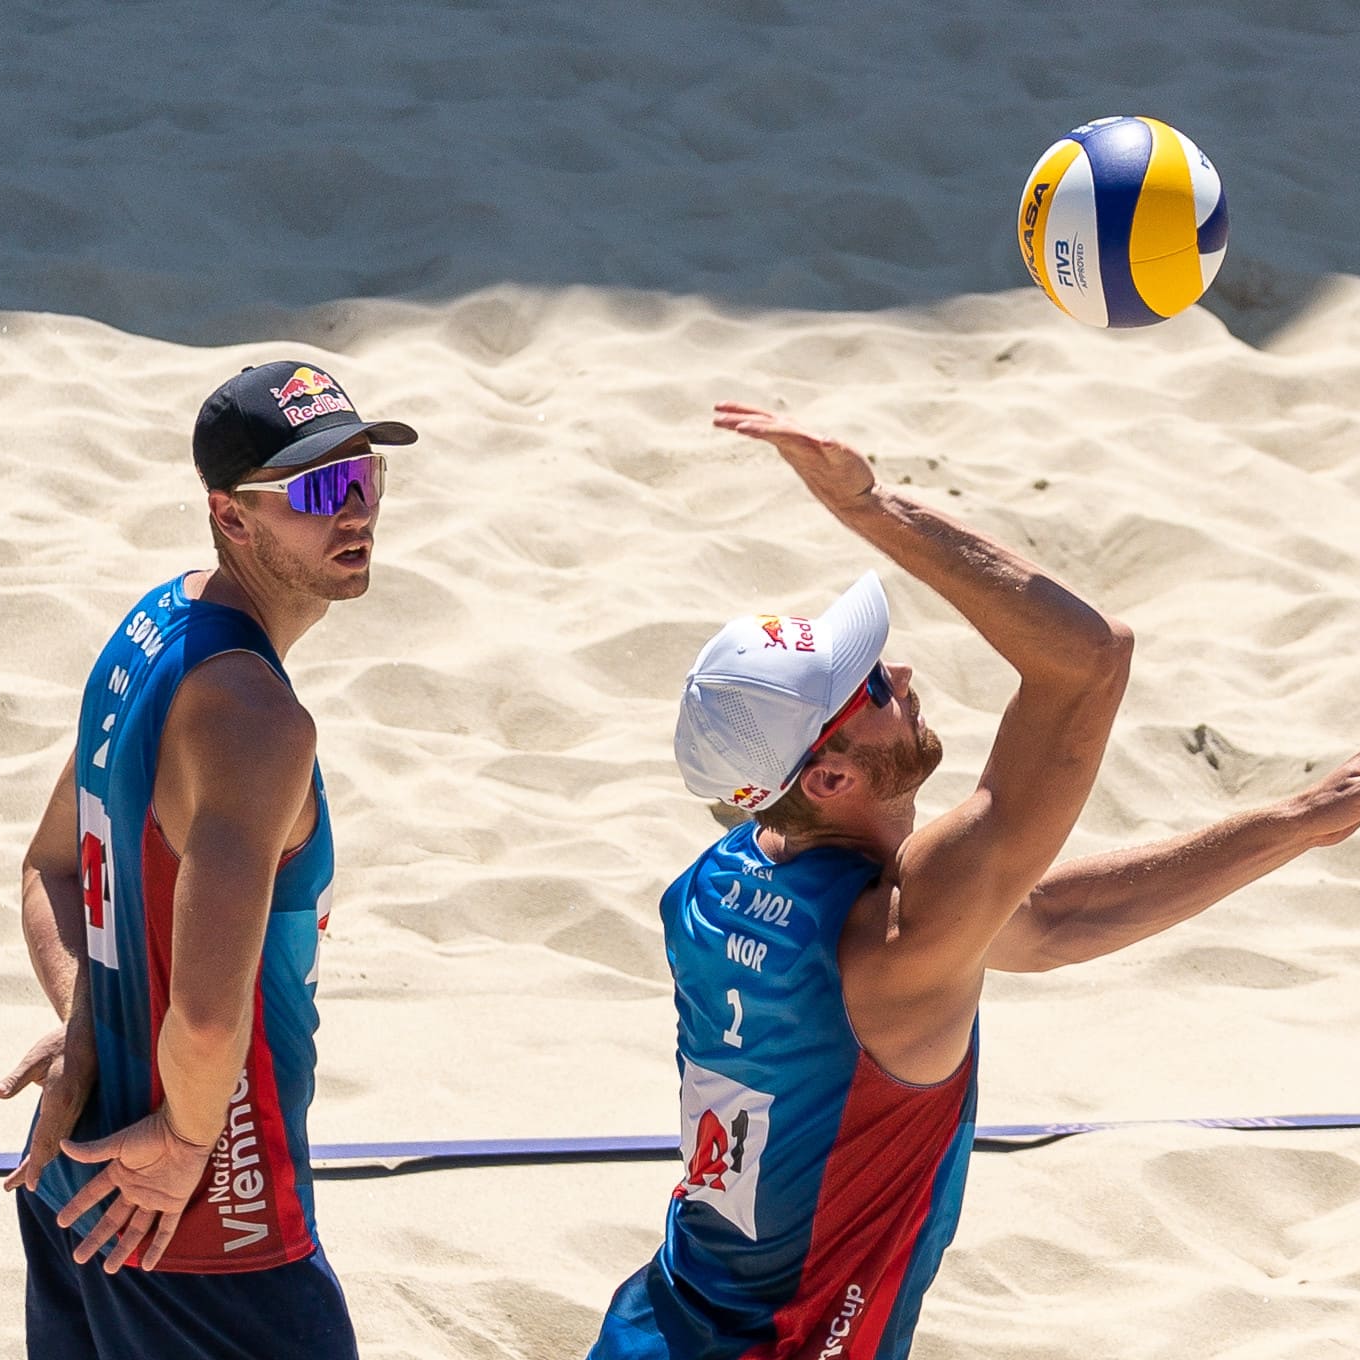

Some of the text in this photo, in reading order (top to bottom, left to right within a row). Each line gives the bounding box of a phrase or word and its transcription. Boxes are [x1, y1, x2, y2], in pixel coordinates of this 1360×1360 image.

[1055, 239, 1074, 288] FIVB
[1076, 243, 1089, 289] APPROVED
[284, 391, 330, 426] Red
[720, 879, 793, 928] A. MOL
[726, 932, 768, 973] NOR
[722, 987, 744, 1049] 1
[208, 1128, 231, 1204] Natio
[830, 1283, 865, 1338] Cup
